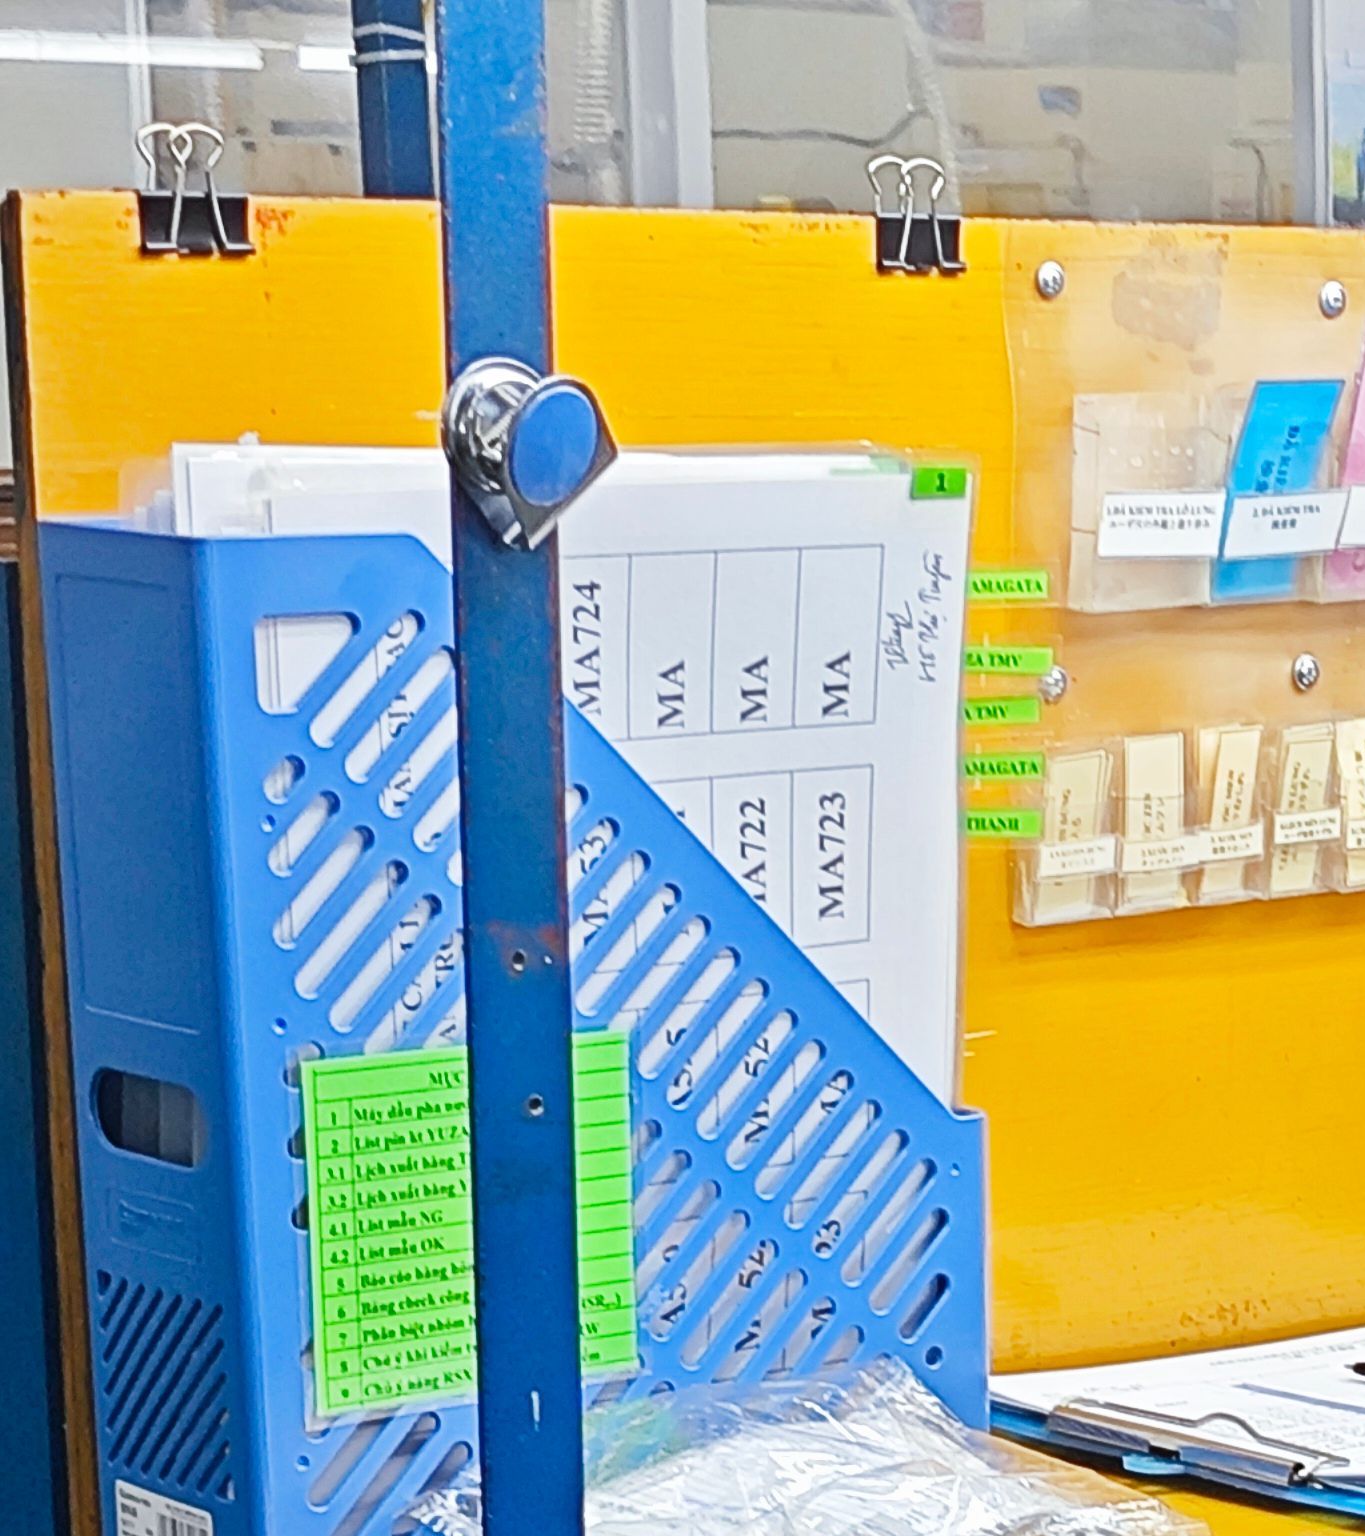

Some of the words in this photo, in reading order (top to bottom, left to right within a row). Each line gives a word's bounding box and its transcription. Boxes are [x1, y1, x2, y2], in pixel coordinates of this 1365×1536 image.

[936, 472, 947, 493] 1
[572, 580, 602, 718] MA724
[657, 660, 686, 730] MA
[740, 655, 770, 725] MA
[822, 650, 852, 719] MA
[739, 797, 767, 903] A722
[817, 791, 847, 922] MA723
